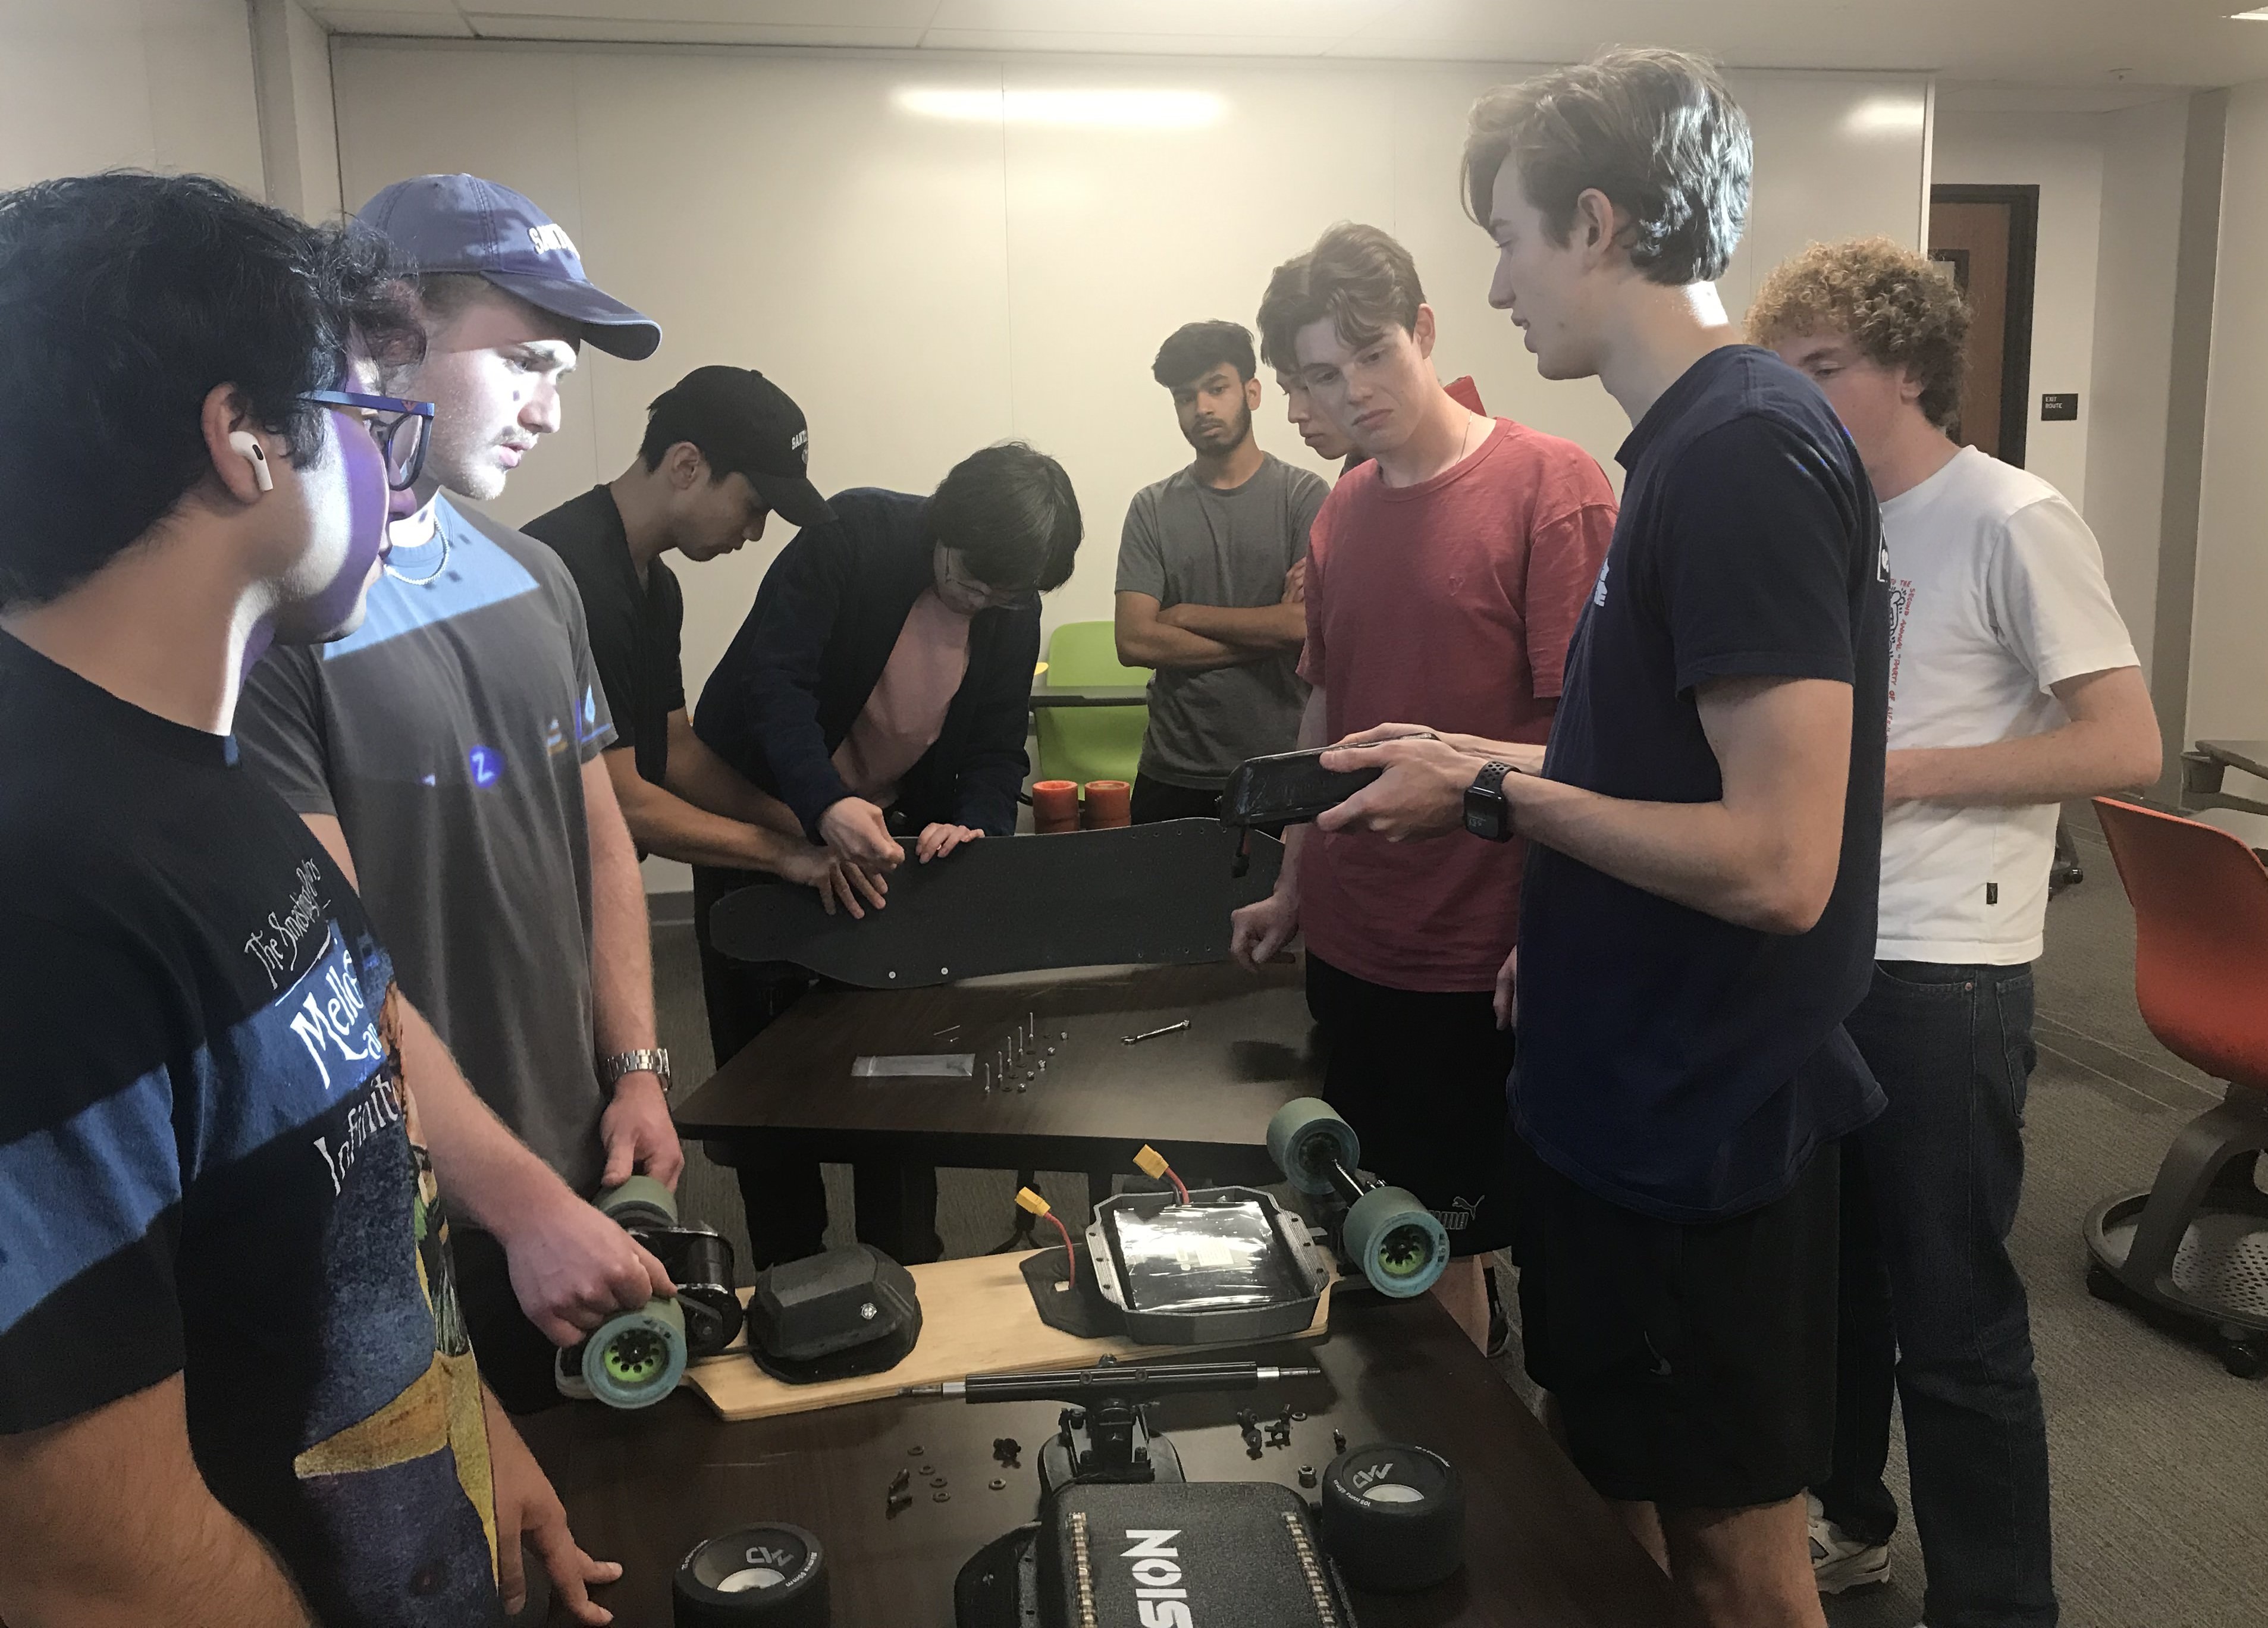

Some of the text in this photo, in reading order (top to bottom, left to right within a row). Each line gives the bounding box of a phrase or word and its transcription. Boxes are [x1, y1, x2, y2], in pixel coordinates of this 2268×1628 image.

[244, 930, 284, 990] The
[268, 886, 320, 971] Smasg
[290, 965, 368, 1090] Mello
[363, 1022, 382, 1060] an
[313, 1073, 400, 1196] Infinit
